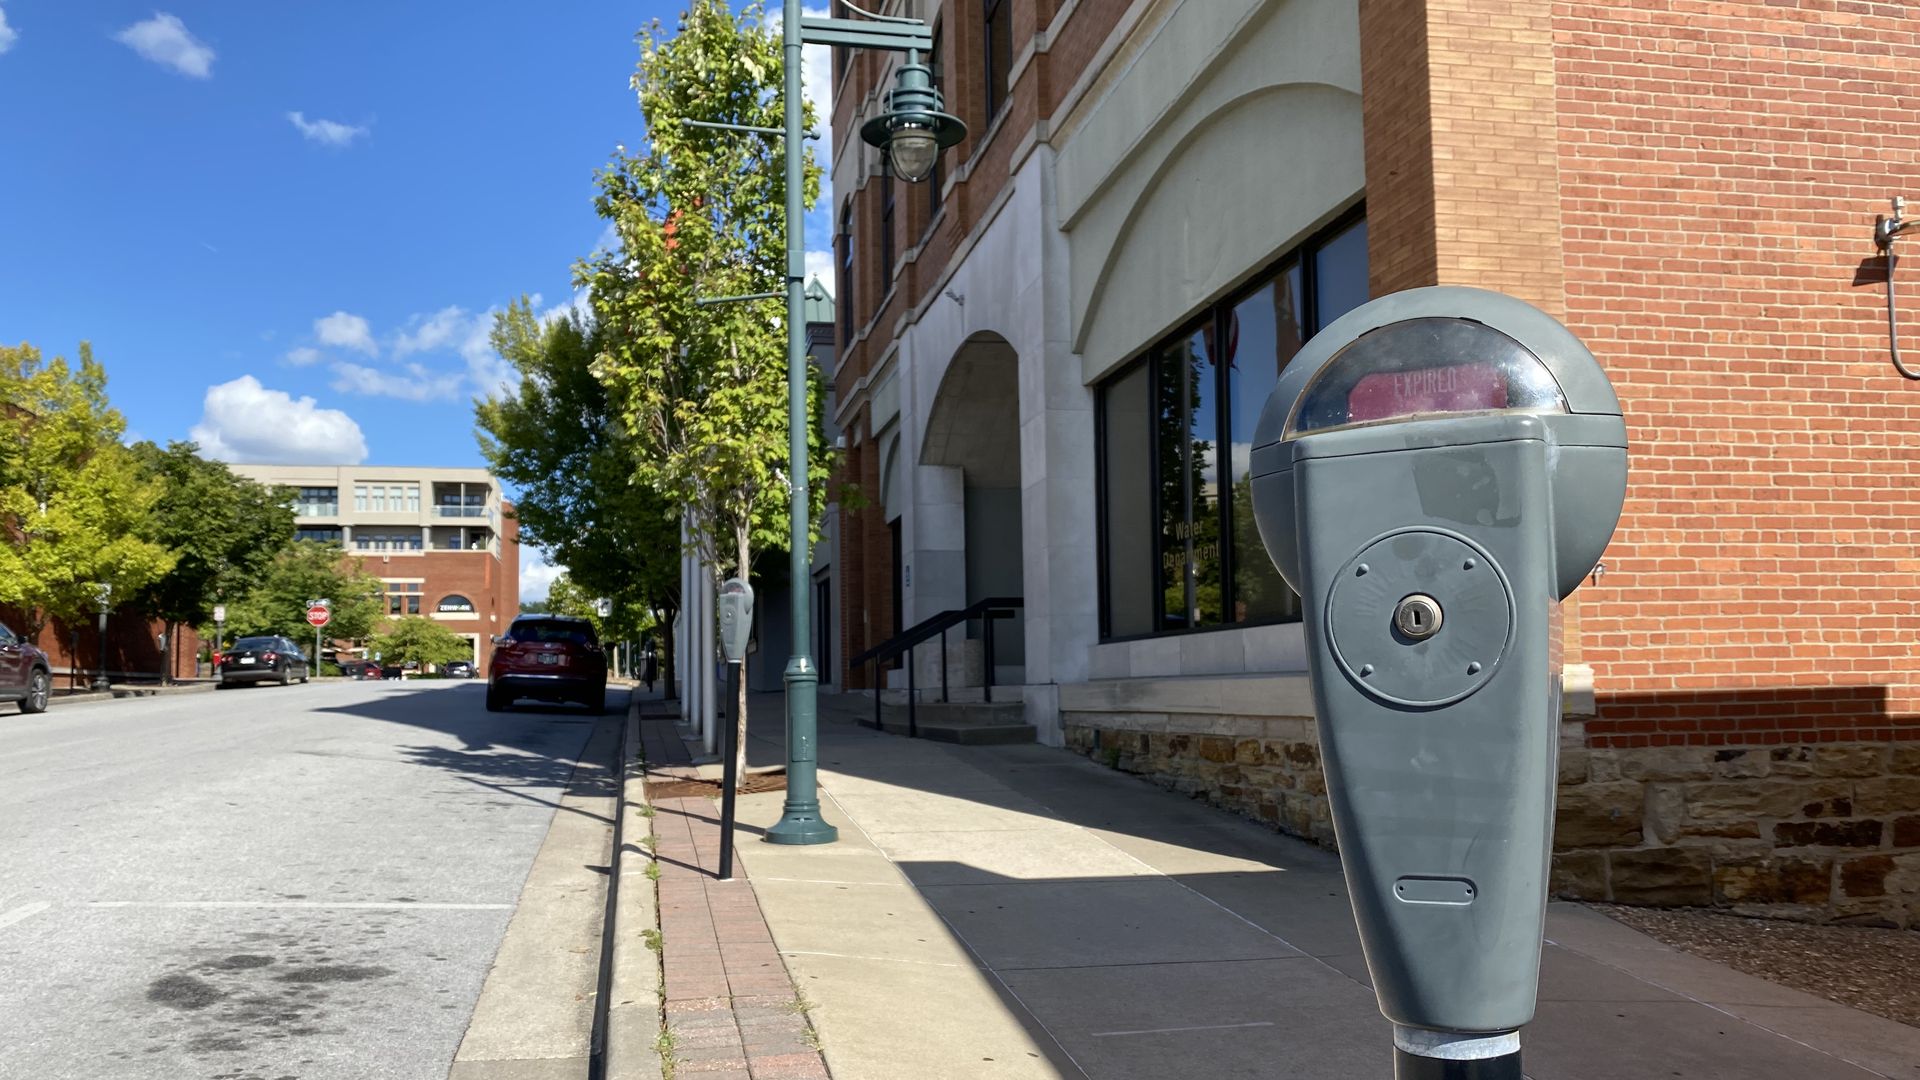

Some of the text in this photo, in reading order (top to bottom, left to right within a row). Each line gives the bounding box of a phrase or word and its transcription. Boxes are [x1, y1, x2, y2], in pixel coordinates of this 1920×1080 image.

[1394, 368, 1457, 398] EXPIRED
[1175, 520, 1204, 541] Water
[309, 611, 328, 621] STOP
